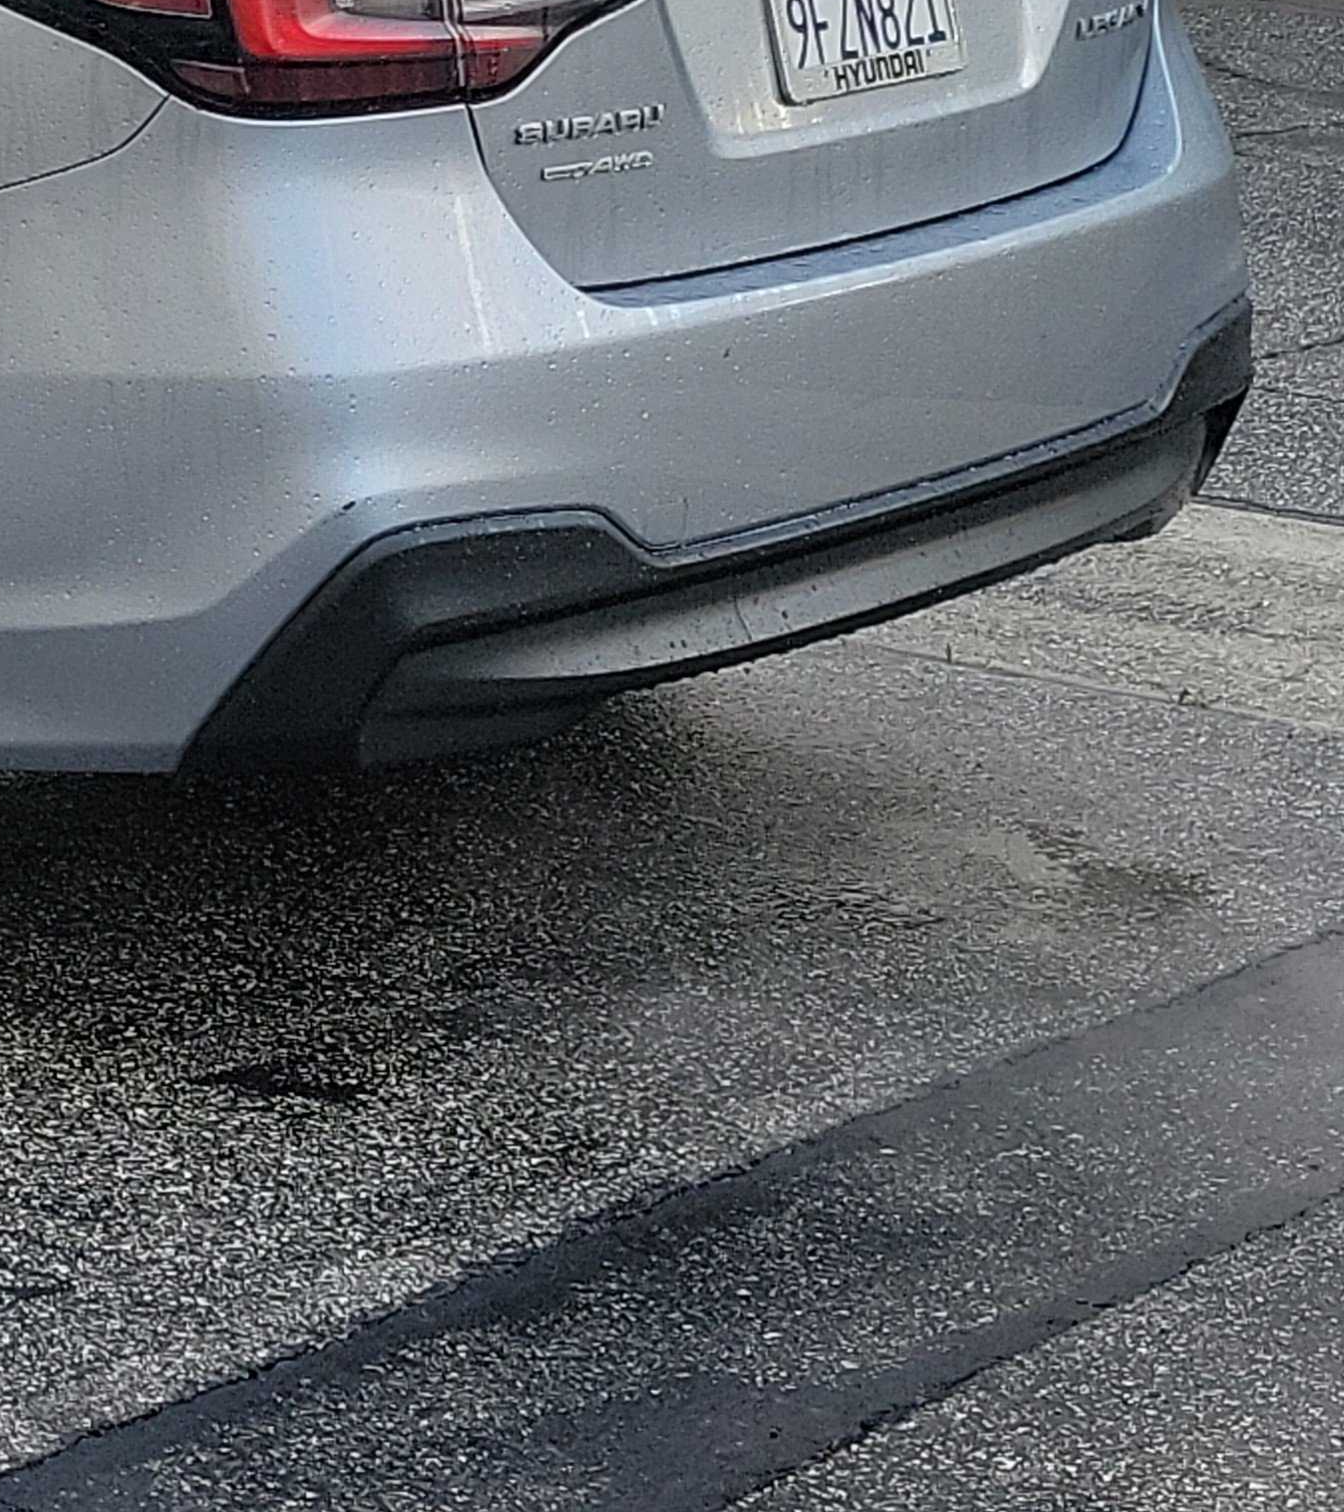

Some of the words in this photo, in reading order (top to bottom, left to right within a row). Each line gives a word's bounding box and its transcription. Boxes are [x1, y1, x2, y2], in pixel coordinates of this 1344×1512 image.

[834, 48, 926, 90] HYUNDAI
[515, 102, 666, 145] SUBARU
[590, 150, 654, 175] AWD
